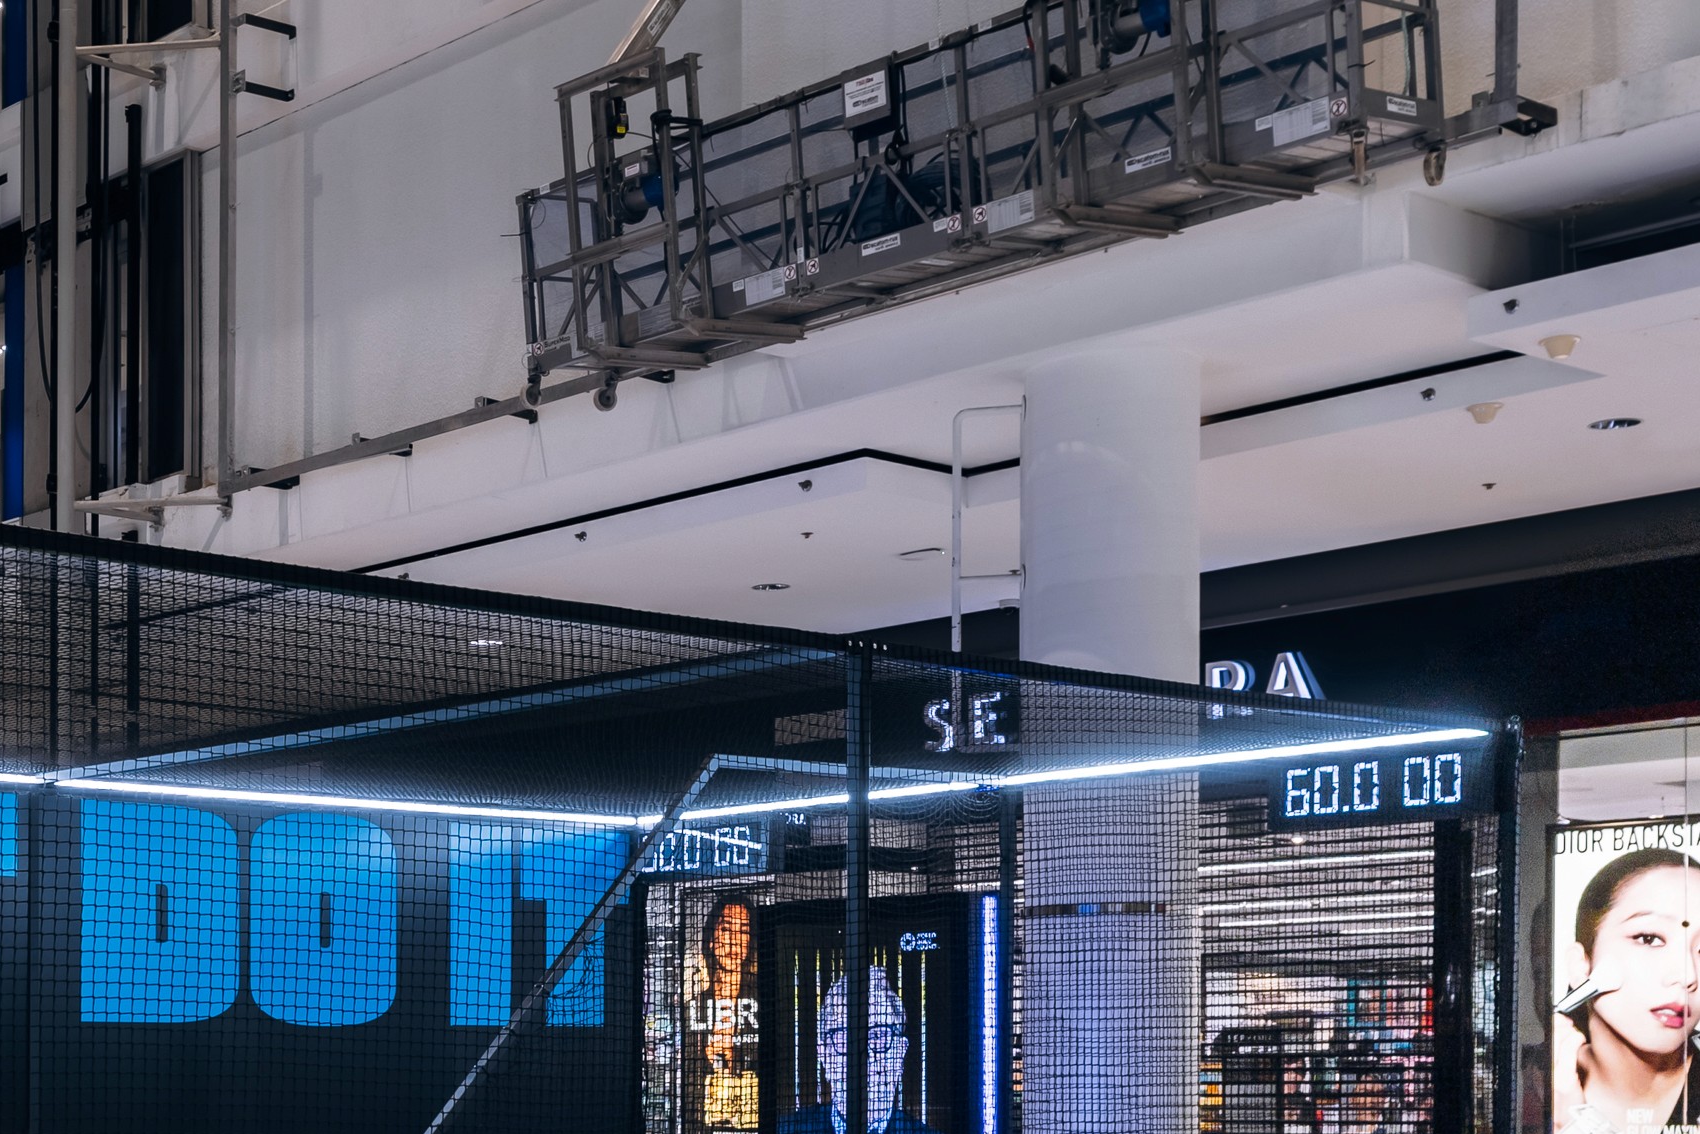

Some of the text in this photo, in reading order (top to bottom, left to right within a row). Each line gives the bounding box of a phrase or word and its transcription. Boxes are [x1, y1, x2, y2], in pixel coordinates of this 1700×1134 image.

[1554, 822, 1700, 855] DIOR BACKST
[81, 797, 399, 1026] DO
[449, 821, 631, 1028] IT
[689, 998, 759, 1031] LIBR
[1626, 1109, 1654, 1124] NEW
